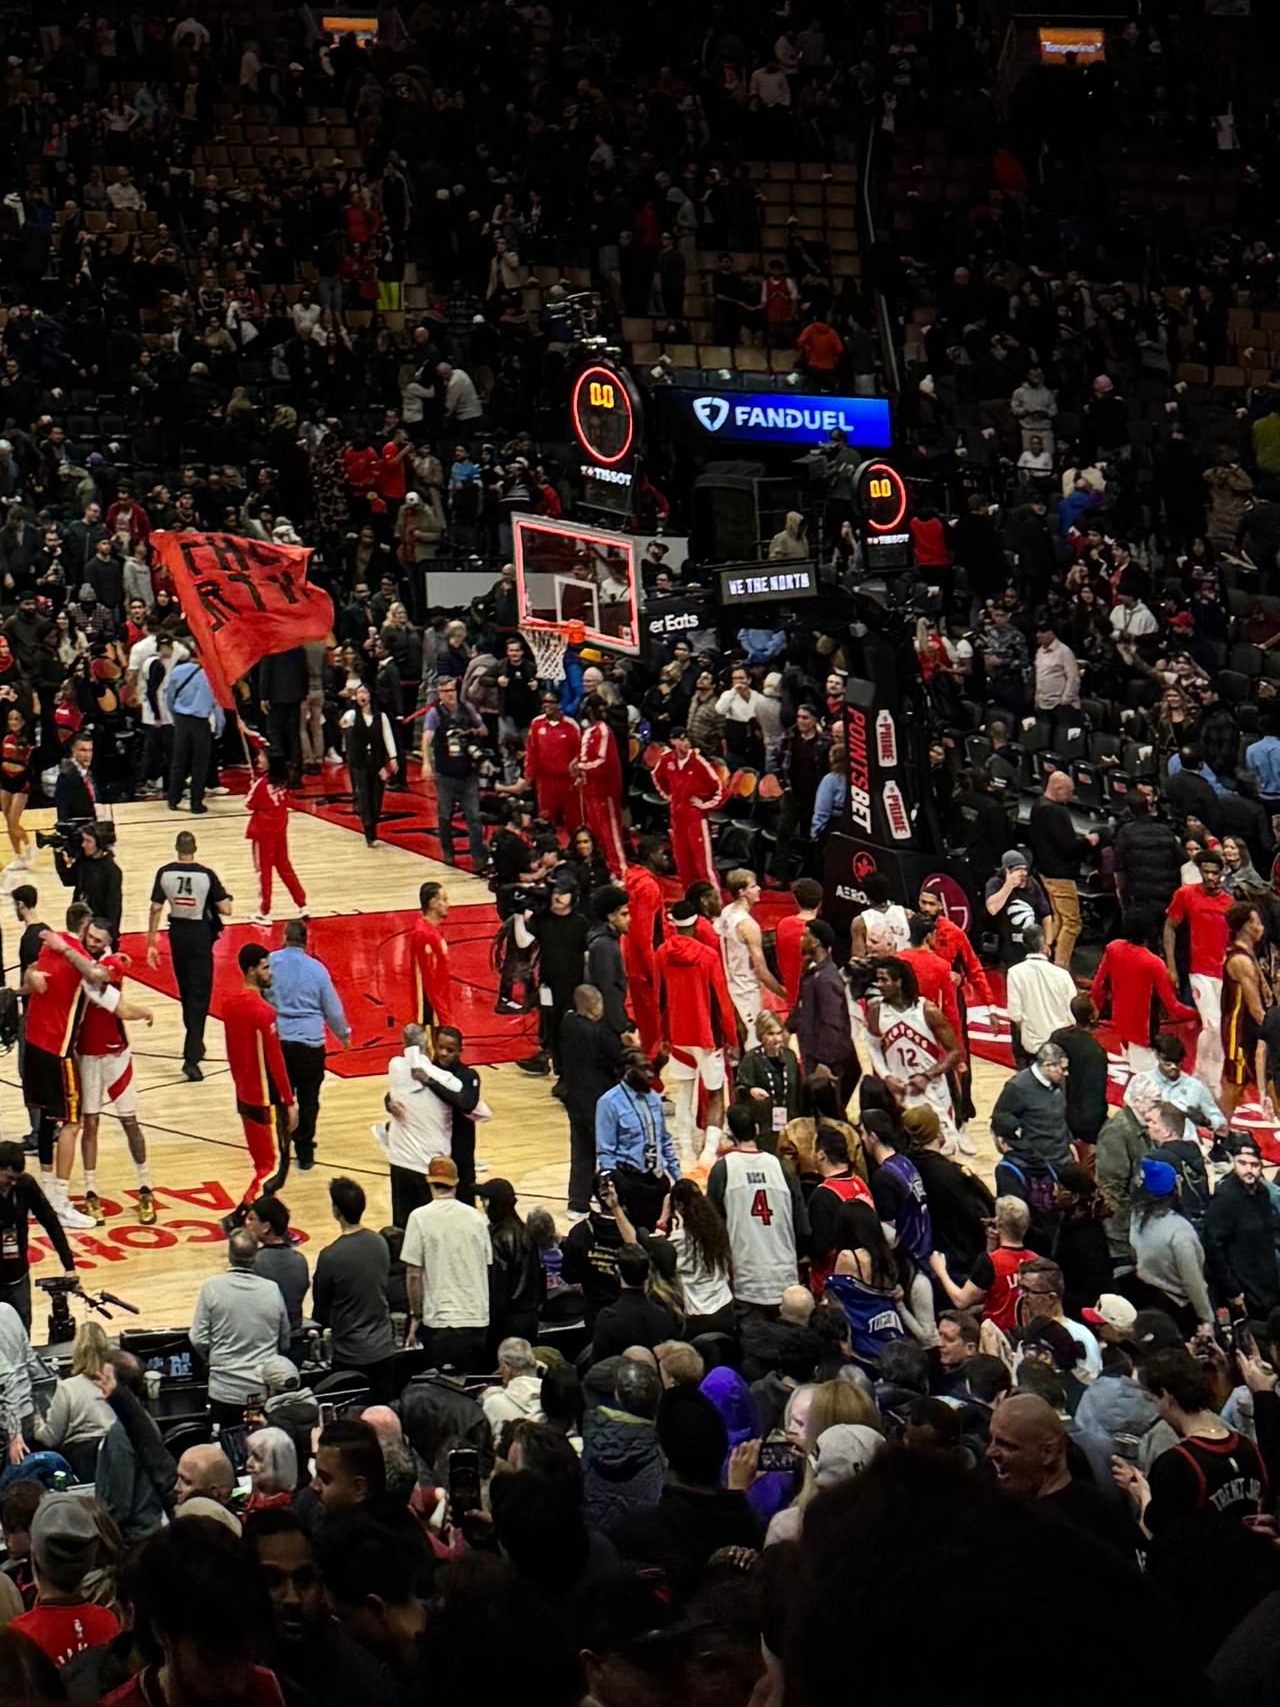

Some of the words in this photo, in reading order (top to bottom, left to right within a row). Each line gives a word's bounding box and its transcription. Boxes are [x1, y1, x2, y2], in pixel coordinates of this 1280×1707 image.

[735, 405, 855, 433] FANDUEL
[666, 612, 699, 633] Eats
[879, 721, 894, 762] PRIME
[887, 793, 907, 834] PRIME
[177, 877, 192, 895] 74
[896, 1048, 917, 1067] 12
[750, 1189, 774, 1226] 4
